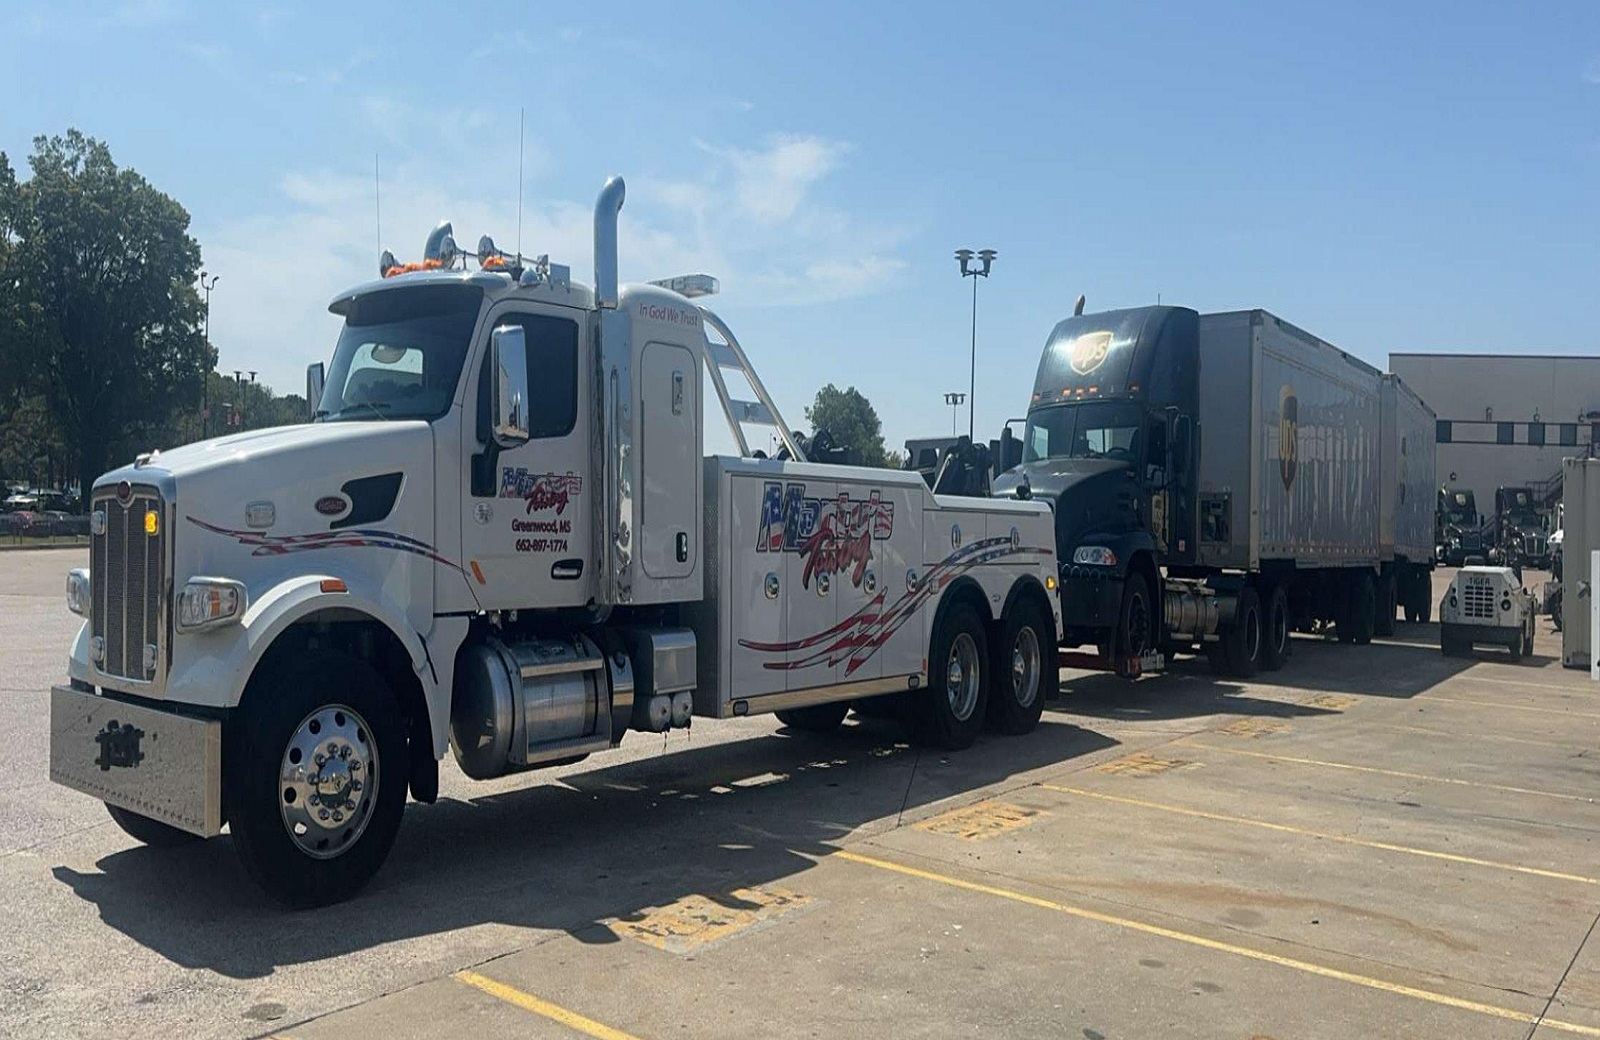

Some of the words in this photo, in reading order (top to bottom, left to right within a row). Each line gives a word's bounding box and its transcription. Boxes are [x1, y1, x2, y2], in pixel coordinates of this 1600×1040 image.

[639, 303, 648, 317] In
[649, 305, 666, 320] God
[667, 307, 679, 323] We
[680, 310, 698, 326] Trust
[511, 518, 558, 534] Greenwood,
[560, 520, 571, 533] MS
[515, 539, 568, 552] 662-897-1774
